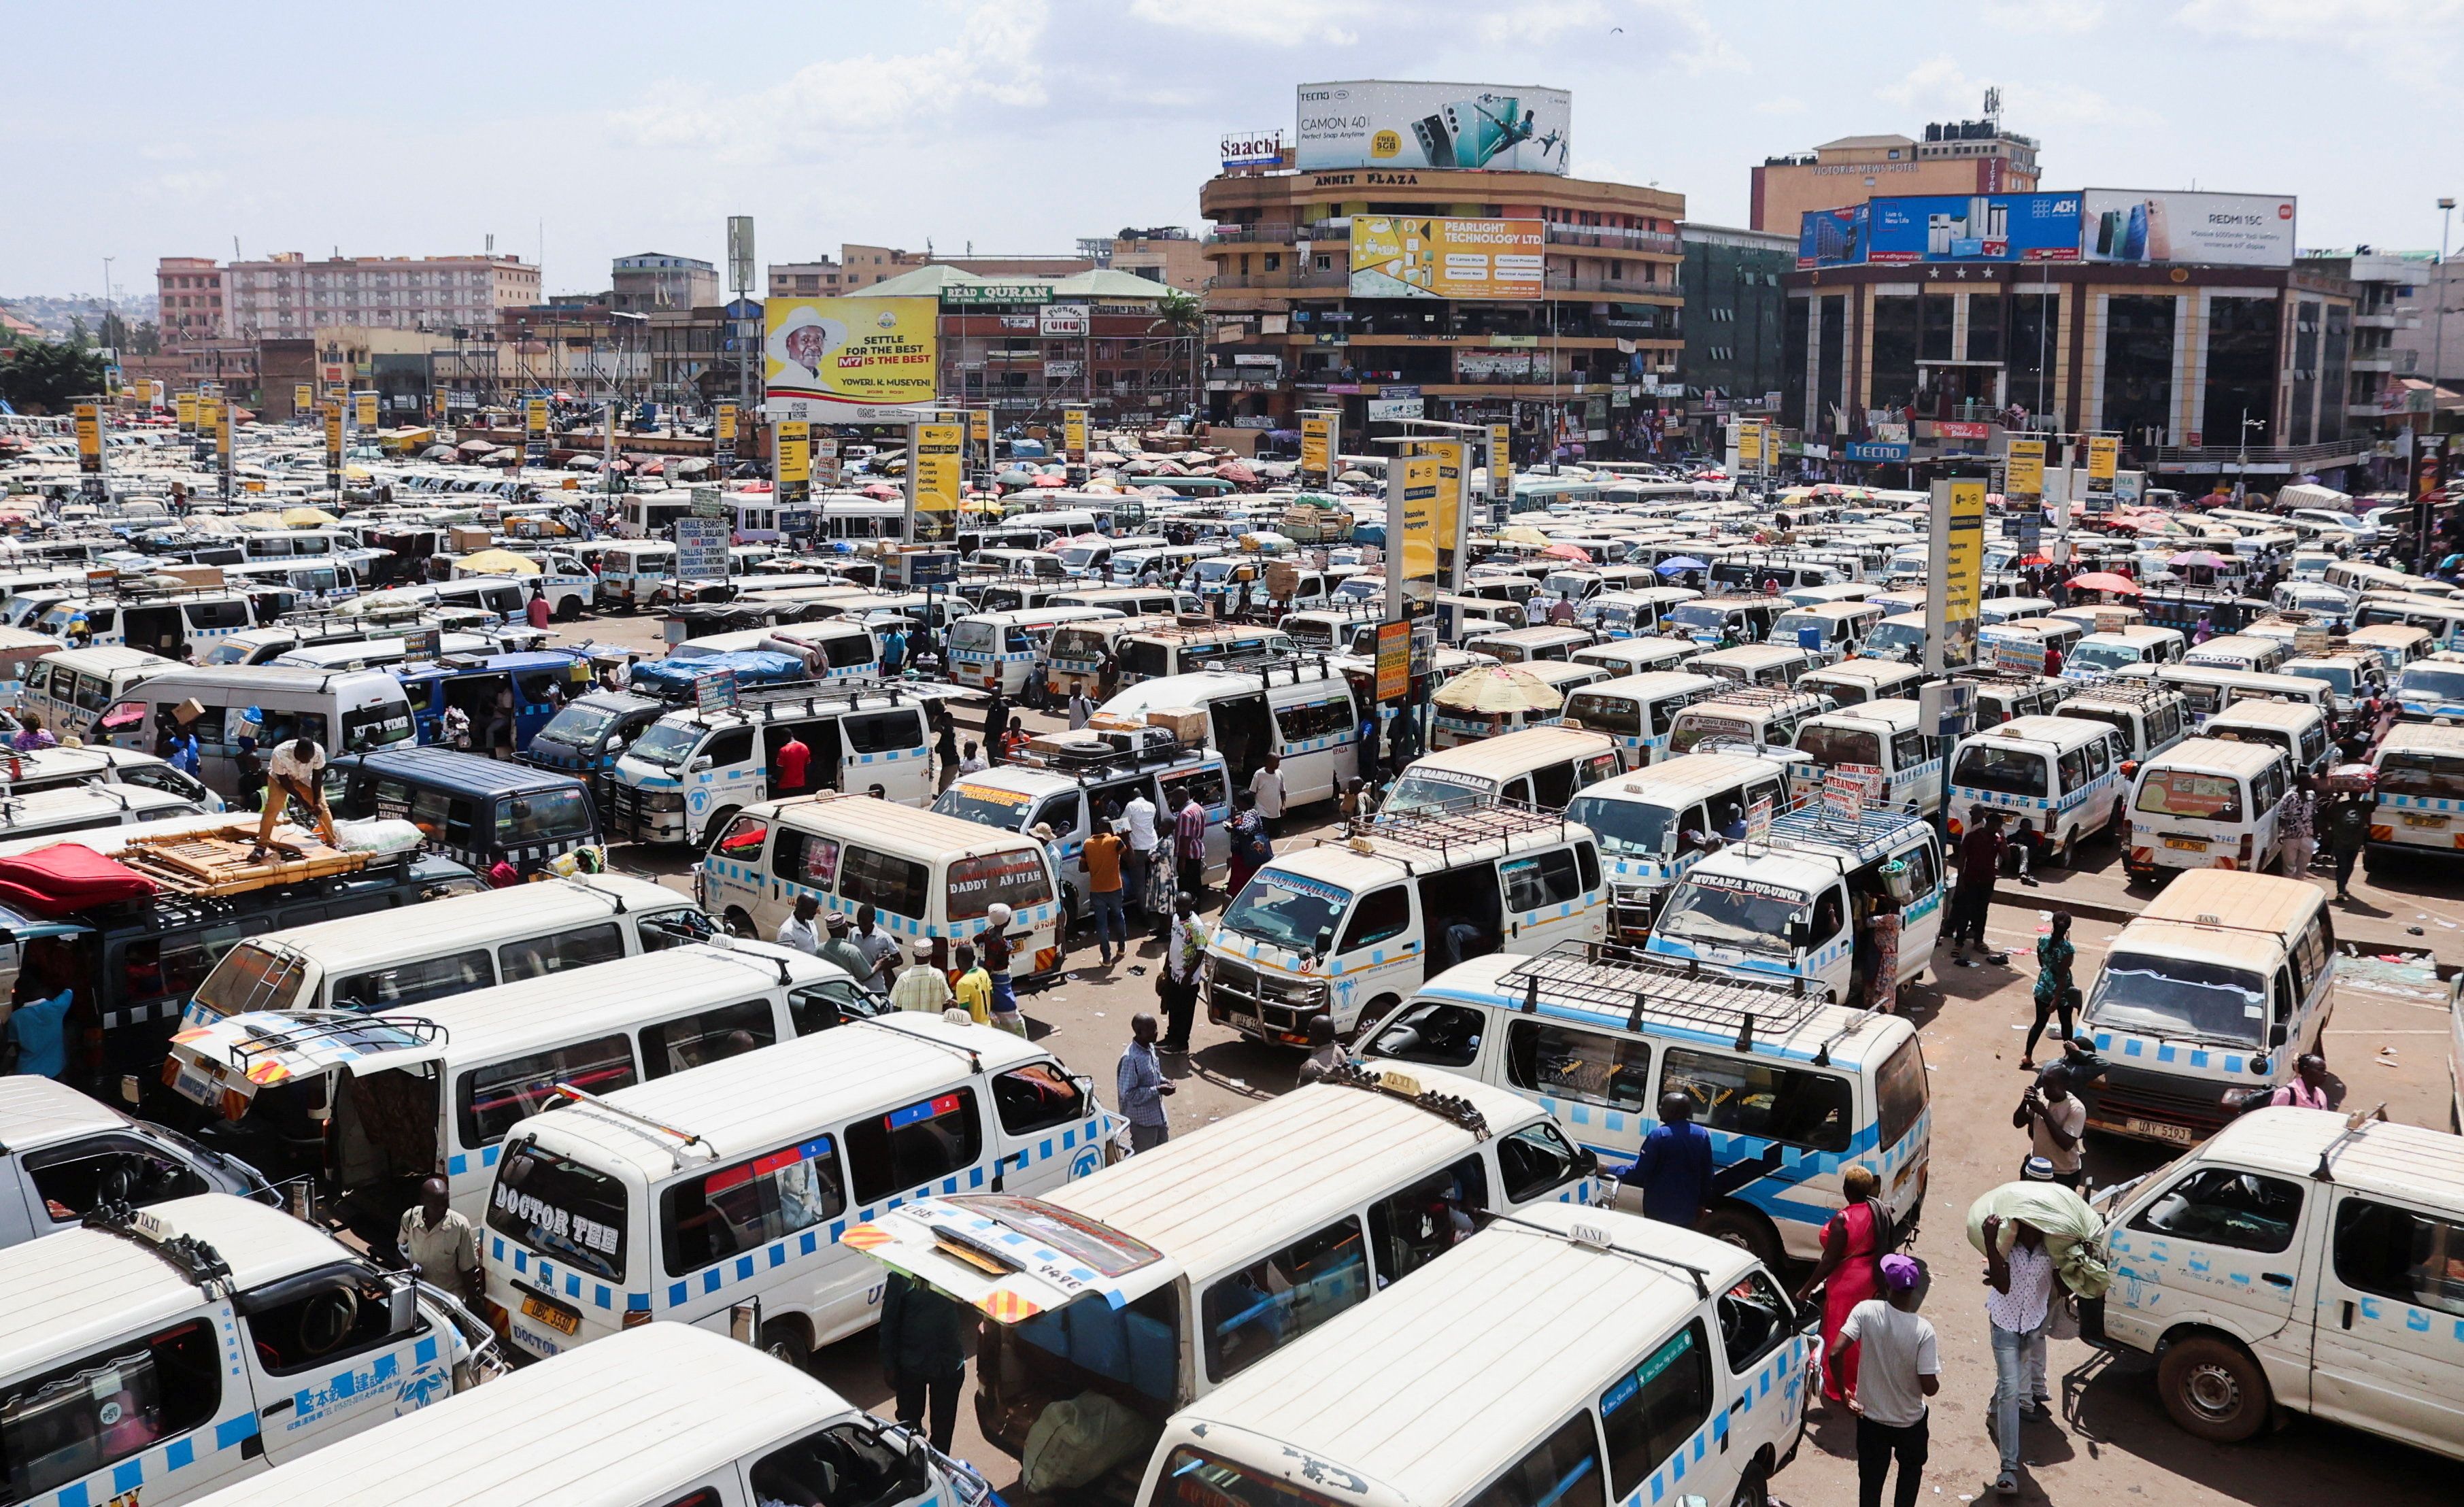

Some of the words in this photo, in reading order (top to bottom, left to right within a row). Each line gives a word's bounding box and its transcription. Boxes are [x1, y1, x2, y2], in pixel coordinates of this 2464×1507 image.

[1300, 92, 1329, 101] TECNO
[1301, 118, 1347, 131] CAMON
[1351, 116, 1366, 129] 40
[1220, 131, 1281, 157] Saachi
[1376, 141, 1396, 150] 9GB
[1812, 166, 1856, 175] VICTORIA
[1859, 165, 1887, 174] MEWS
[1889, 163, 1919, 173] HOTEL
[1314, 174, 1355, 186] ANNET
[1367, 173, 1418, 184] PLAZA
[2051, 200, 2077, 214] ADH
[2208, 214, 2242, 225] REDMI
[2244, 214, 2263, 226] 15C
[1445, 221, 1506, 234] PEARLIGHT
[1445, 233, 1520, 244] TECHNOLOGY
[1522, 235, 1544, 245] LTD.
[947, 288, 977, 297] READ
[983, 286, 1048, 298] QURAN
[1047, 306, 1083, 318] Pioneer
[864, 335, 904, 345] SETTLE
[871, 346, 892, 354] THE
[895, 345, 924, 354] BEST
[839, 357, 862, 367] M7
[864, 357, 875, 365] IS
[877, 356, 899, 365] THE
[902, 354, 931, 364] BEST
[1855, 446, 1901, 458] TECNO
[691, 538, 701, 547] VIA
[1533, 603, 1542, 612] 14
[2201, 655, 2247, 666] TOYOTA
[384, 715, 409, 732] TIME
[1720, 719, 1746, 728] ESTATES
[1863, 766, 1879, 775] TASO
[2133, 824, 2152, 832] UAY
[949, 879, 988, 894] DADDY
[1690, 873, 1742, 891] MUKAMA
[1745, 881, 1802, 902] MULUNGI
[2198, 915, 2218, 924] TAXI
[1301, 959, 1310, 970] 3
[947, 1011, 964, 1021] TAXI
[1387, 1073, 1411, 1088] TAXI
[2139, 1122, 2156, 1134] UAY
[2162, 1126, 2186, 1140] 519J
[140, 1212, 161, 1233] TAXI
[494, 1182, 569, 1236] DOCTOR
[571, 1214, 619, 1257] TEE
[1574, 1225, 1603, 1242] TAXI
[531, 1301, 550, 1319] UBC
